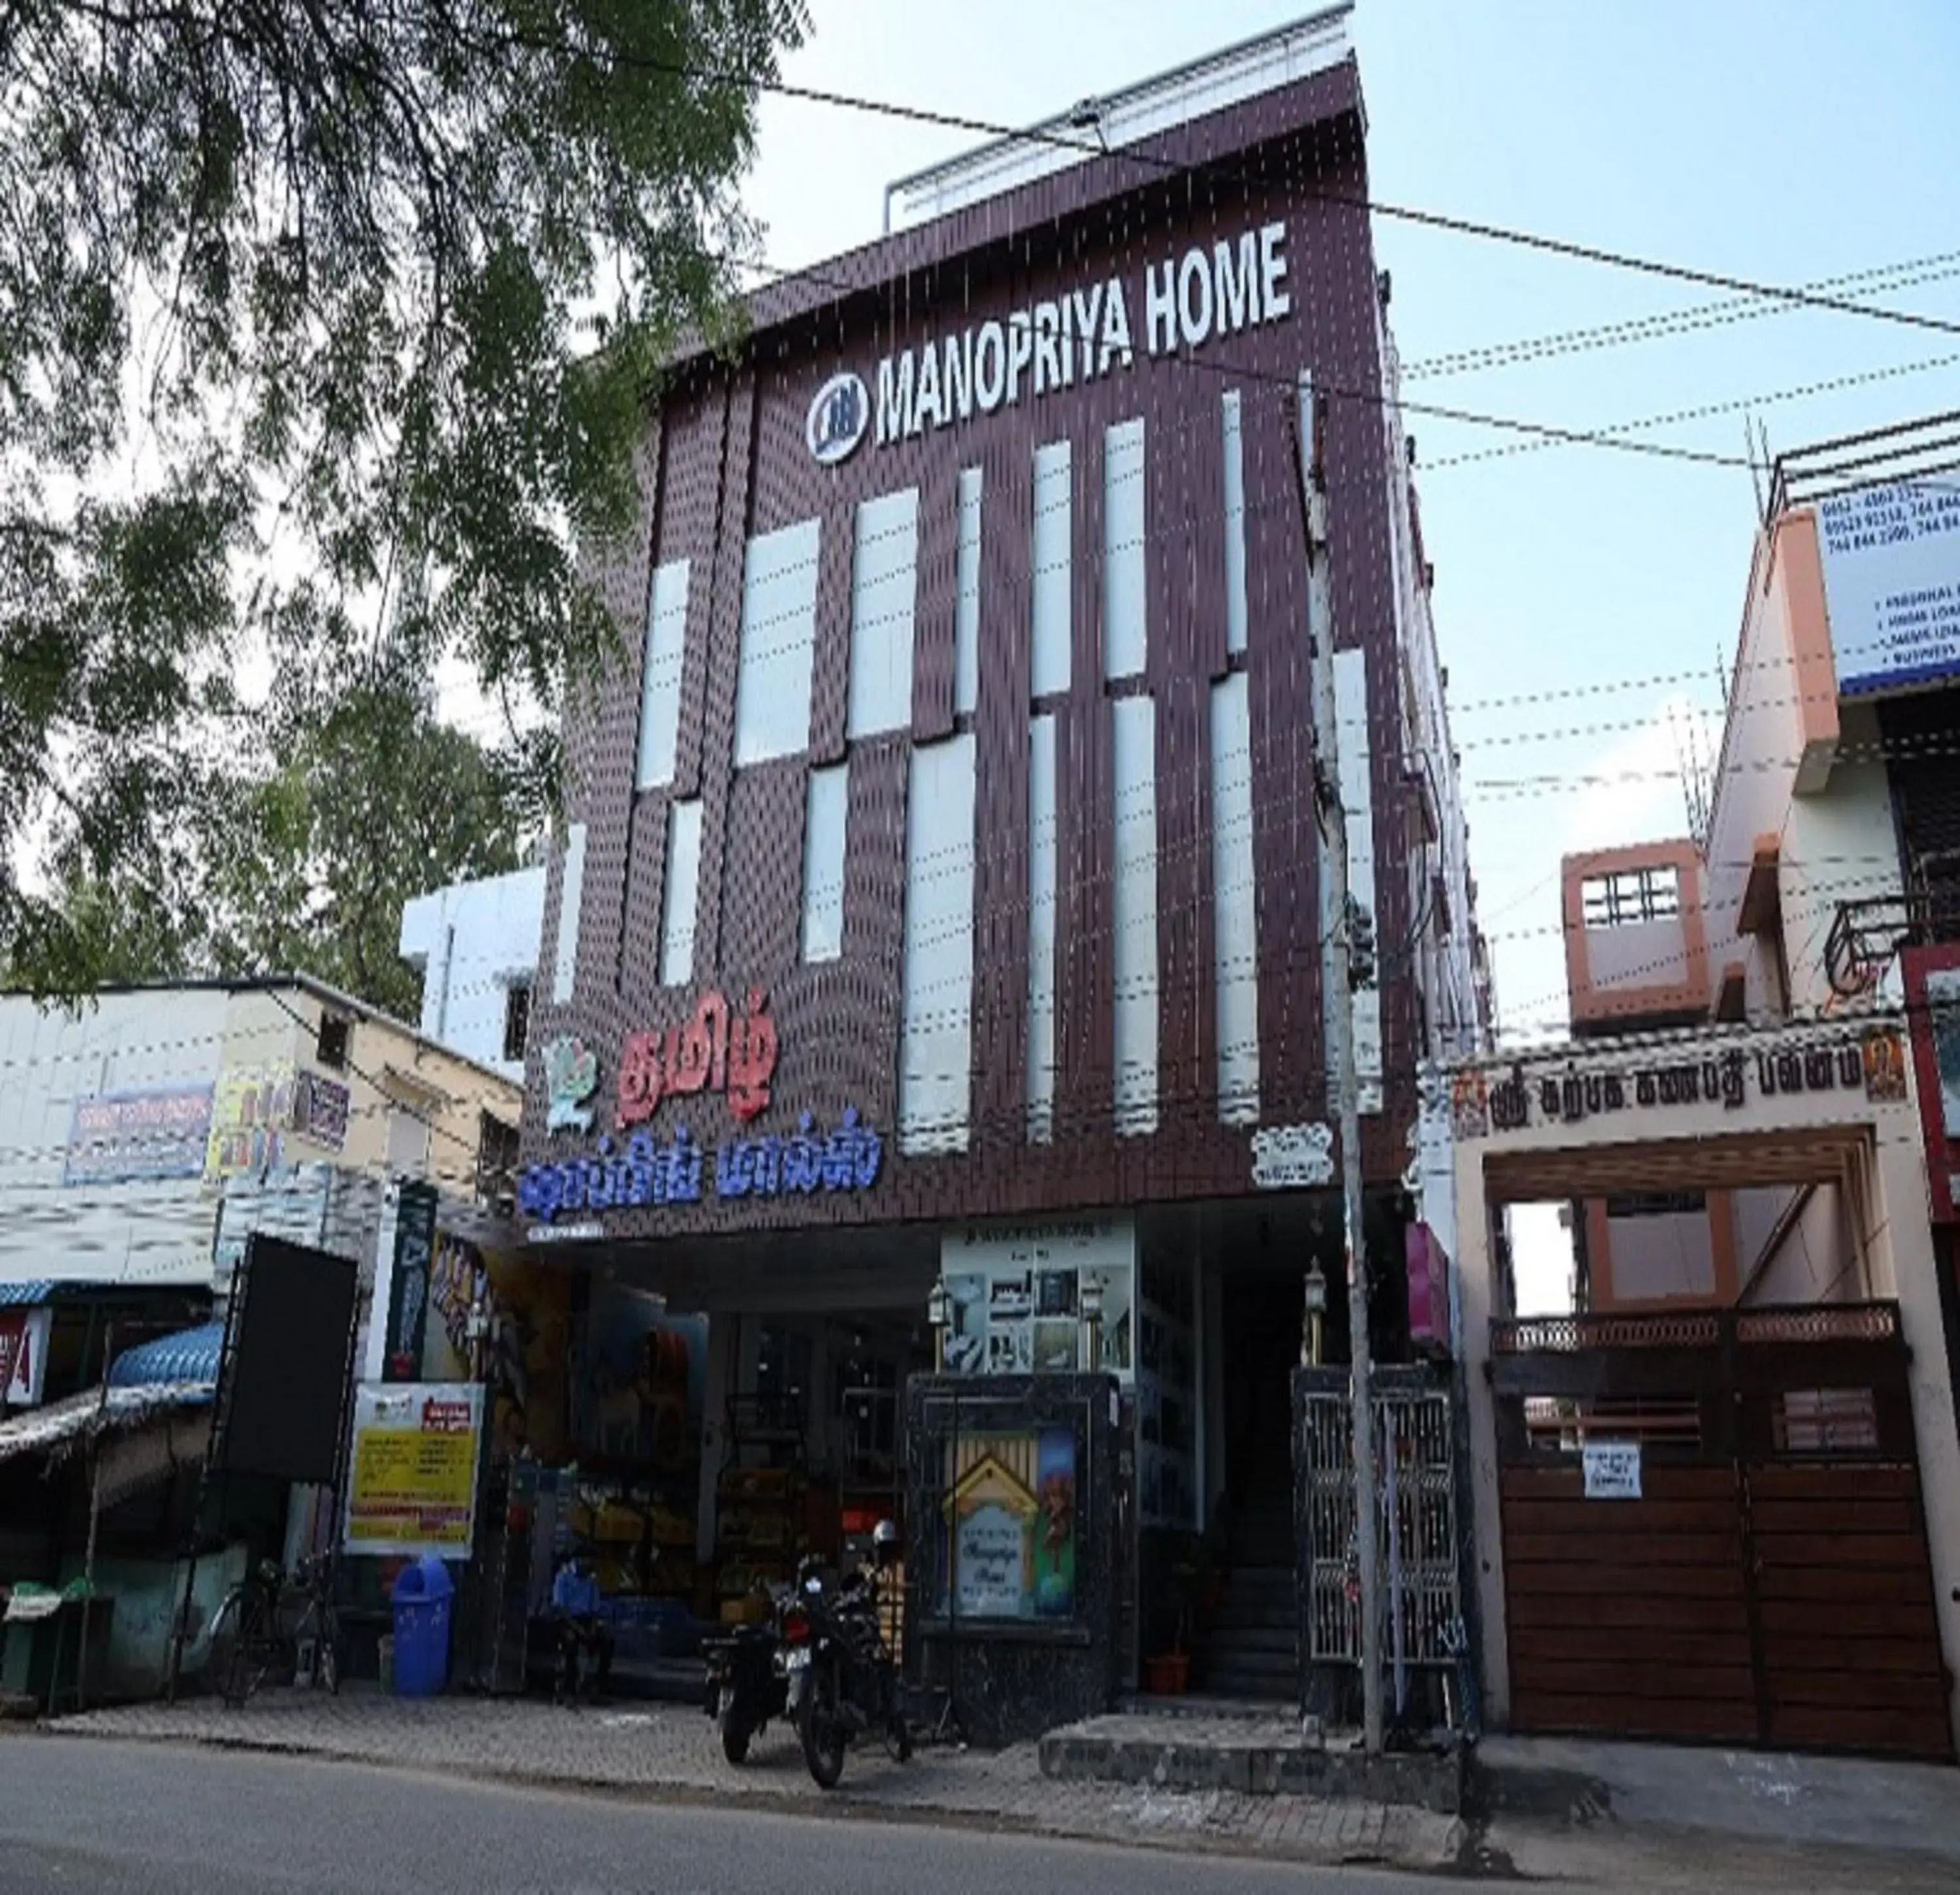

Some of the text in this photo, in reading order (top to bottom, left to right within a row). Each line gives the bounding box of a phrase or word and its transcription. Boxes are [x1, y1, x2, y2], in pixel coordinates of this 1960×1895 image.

[875, 221, 1292, 447] MANOPRIYA HOME
[615, 983, 777, 1130] தமிழ்
